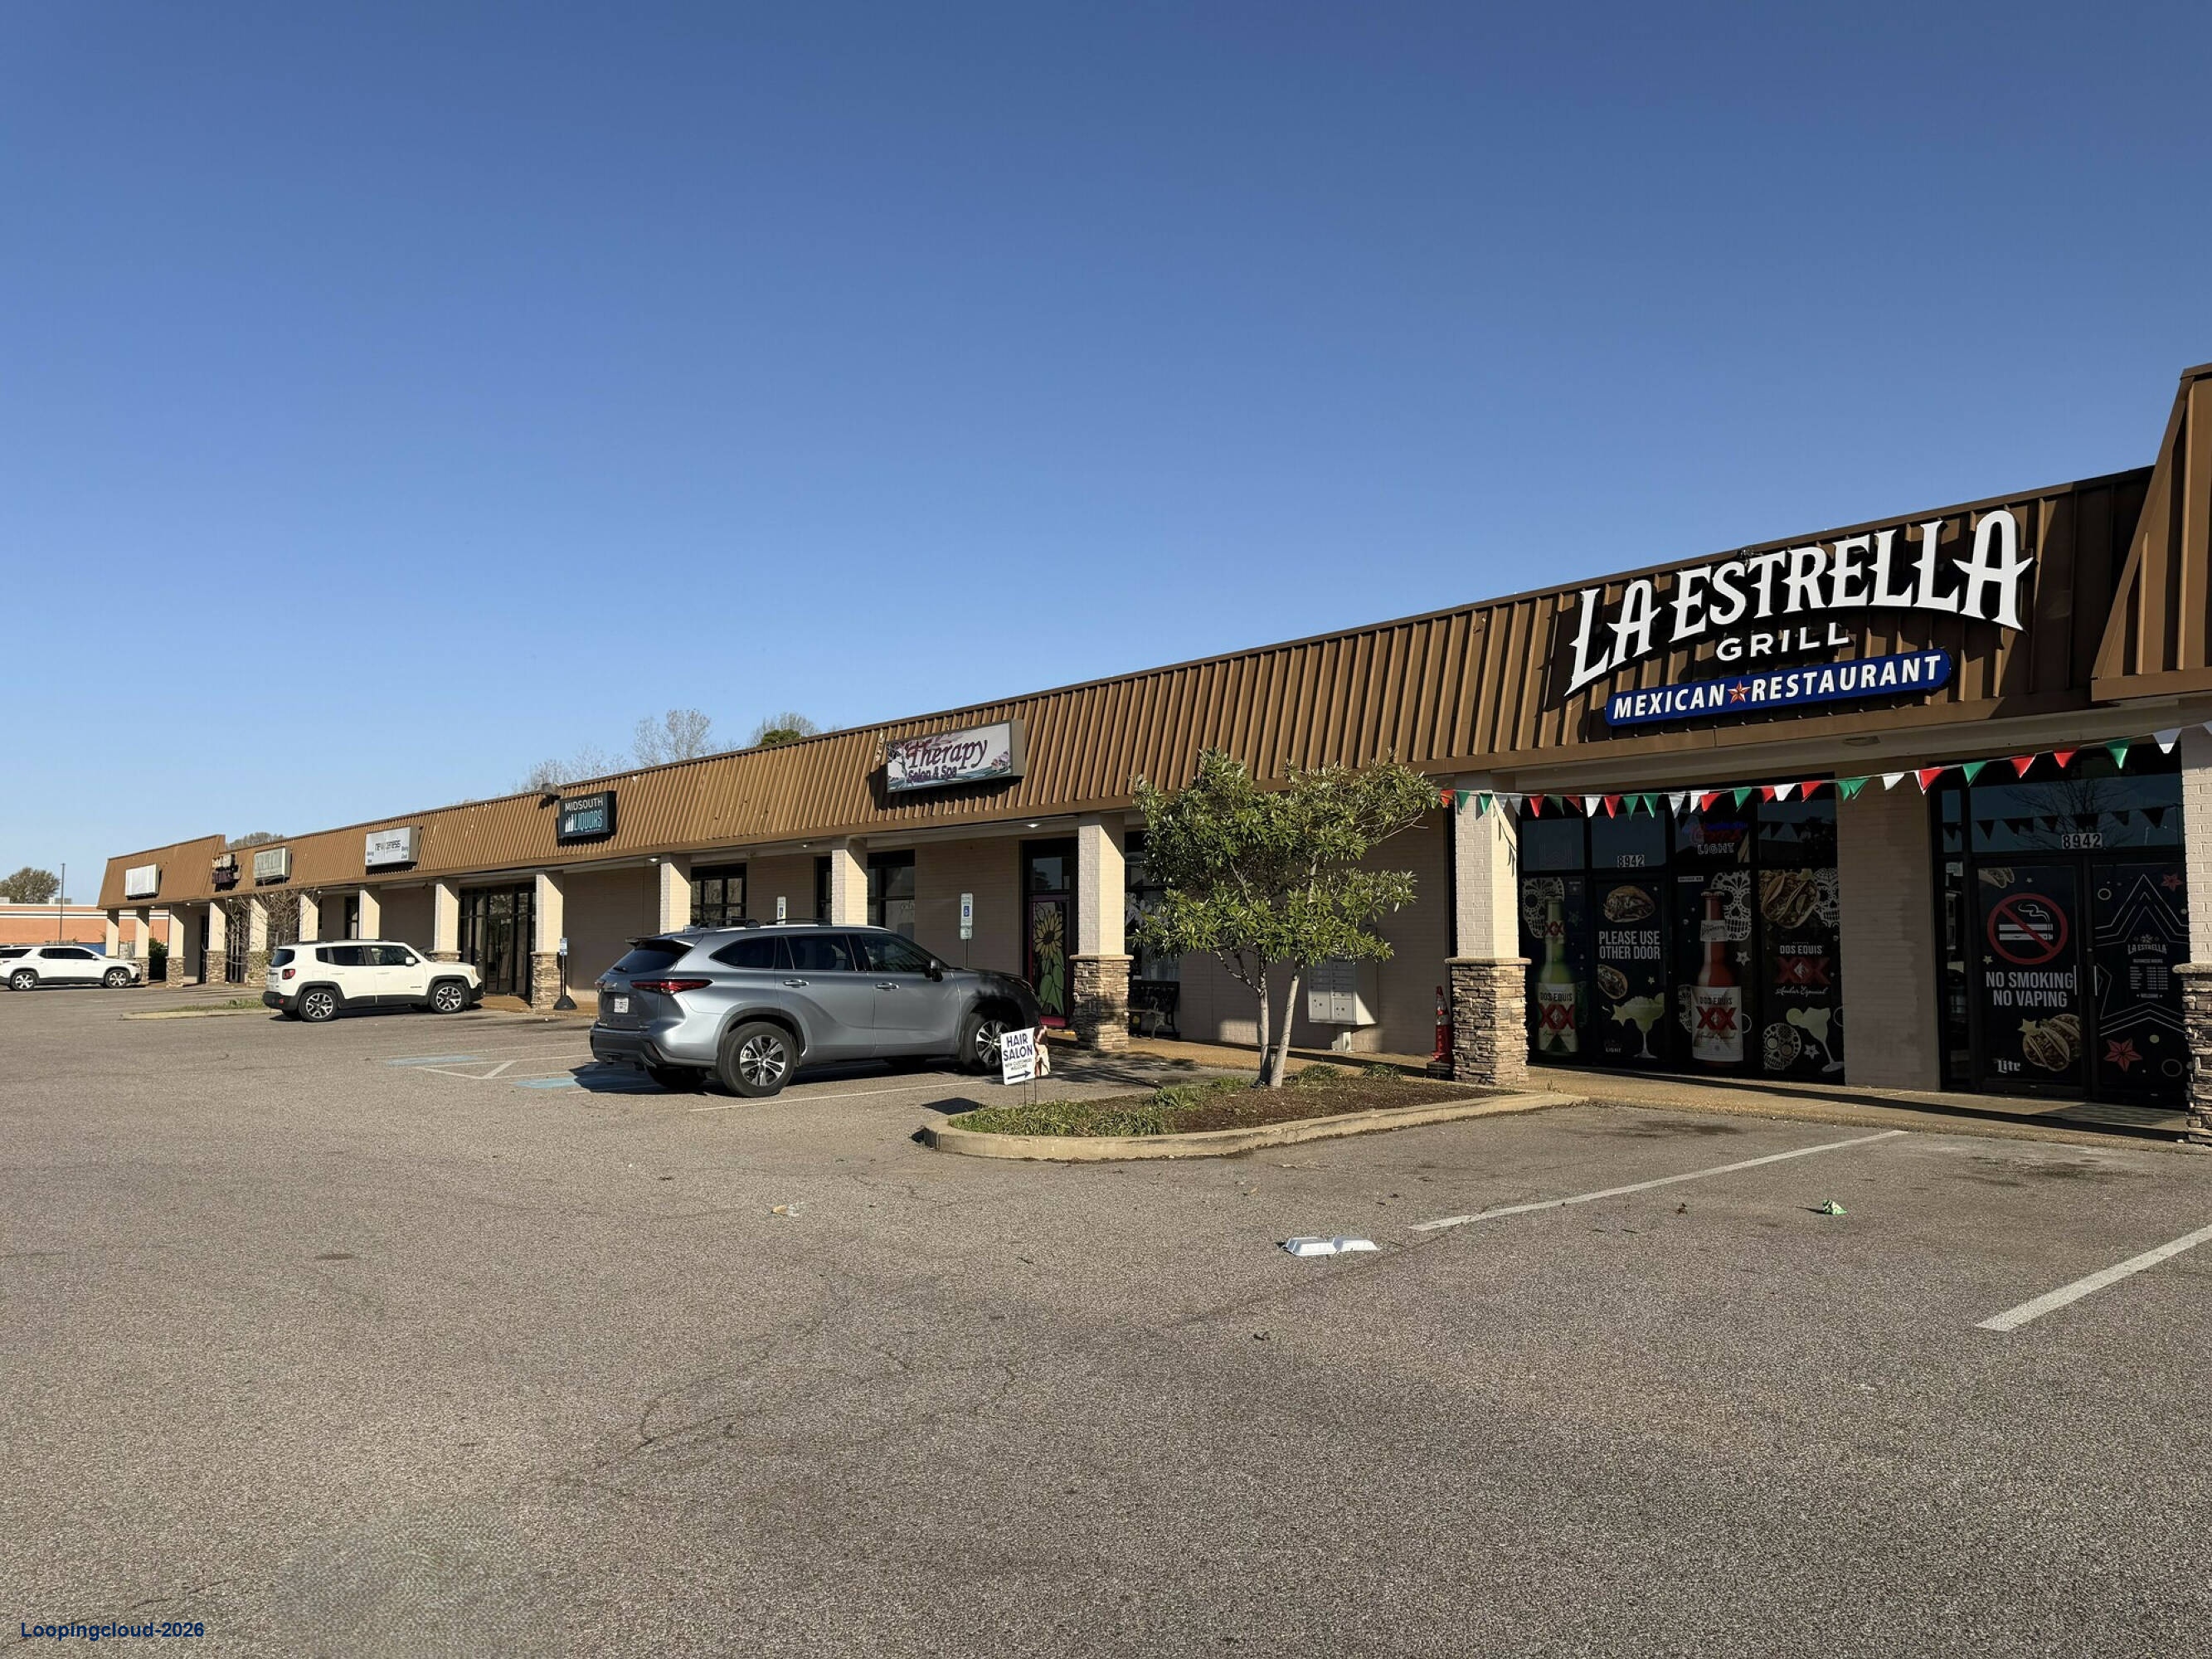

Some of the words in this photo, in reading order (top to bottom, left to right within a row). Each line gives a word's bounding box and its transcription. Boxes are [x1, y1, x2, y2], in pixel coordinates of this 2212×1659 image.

[1563, 580, 1660, 697] LA
[1668, 510, 2035, 642] ESTRELLA
[1716, 622, 1850, 661] GRILL
[1613, 683, 1725, 720] MEXICAN
[1750, 654, 1942, 702] RESTAURANT
[906, 739, 988, 770] Therapy
[565, 796, 604, 812] MIDSOUTH
[2064, 834, 2101, 849] 8942
[1618, 855, 1644, 868] 8942
[1599, 930, 1638, 945] PLEASE
[1640, 930, 1660, 945] USE
[1599, 946, 1631, 960] OTHER
[1633, 946, 1660, 960] DOOR
[1780, 945, 1796, 955] DOS
[1797, 945, 1822, 955] EQUIS
[1986, 971, 2005, 989] NO
[2008, 971, 2073, 989] SMOKING
[1993, 990, 2012, 1006] NO
[2015, 990, 2068, 1008] VAPING
[1006, 1033, 1028, 1048] HAIR
[1003, 1044, 1033, 1061] SALON
